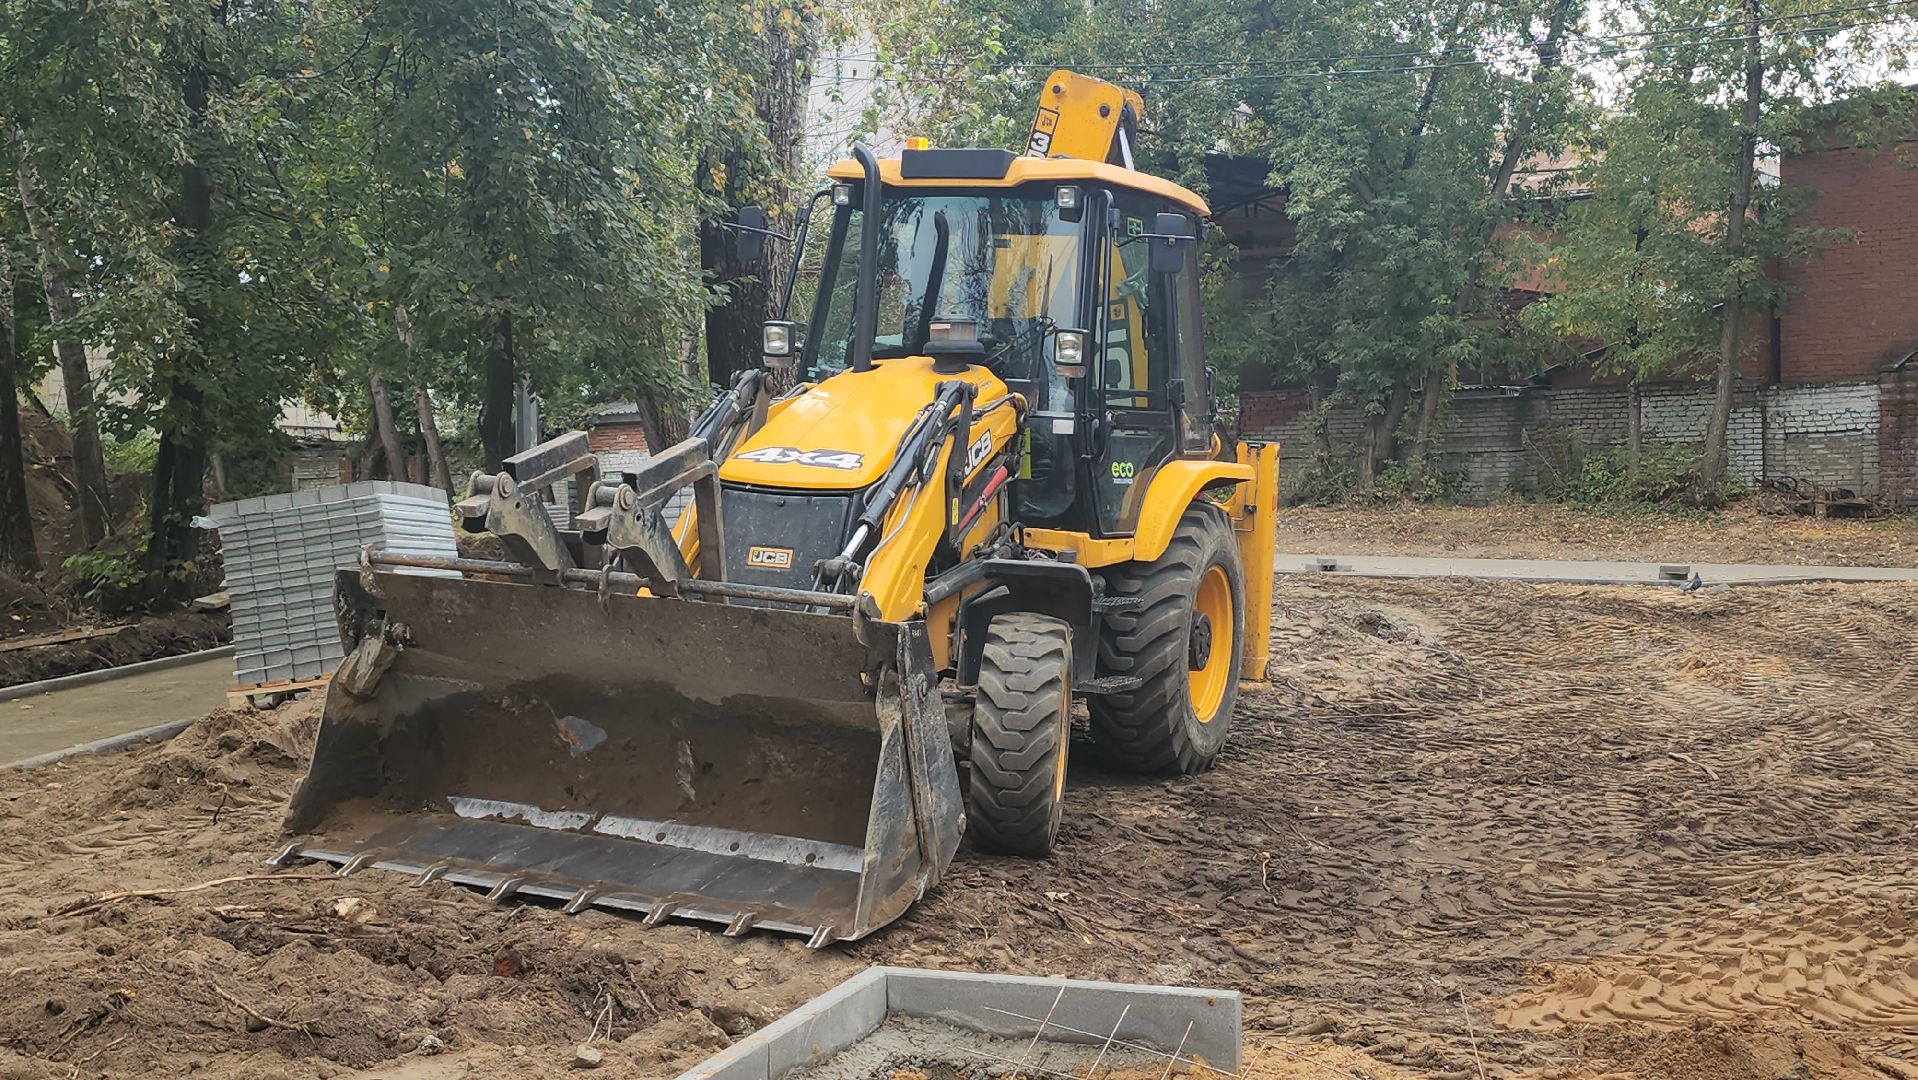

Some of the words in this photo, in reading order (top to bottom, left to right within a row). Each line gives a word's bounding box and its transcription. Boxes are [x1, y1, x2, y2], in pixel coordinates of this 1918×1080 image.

[964, 430, 992, 475] JCB
[1111, 461, 1134, 478] eco
[752, 550, 788, 564] JCB
